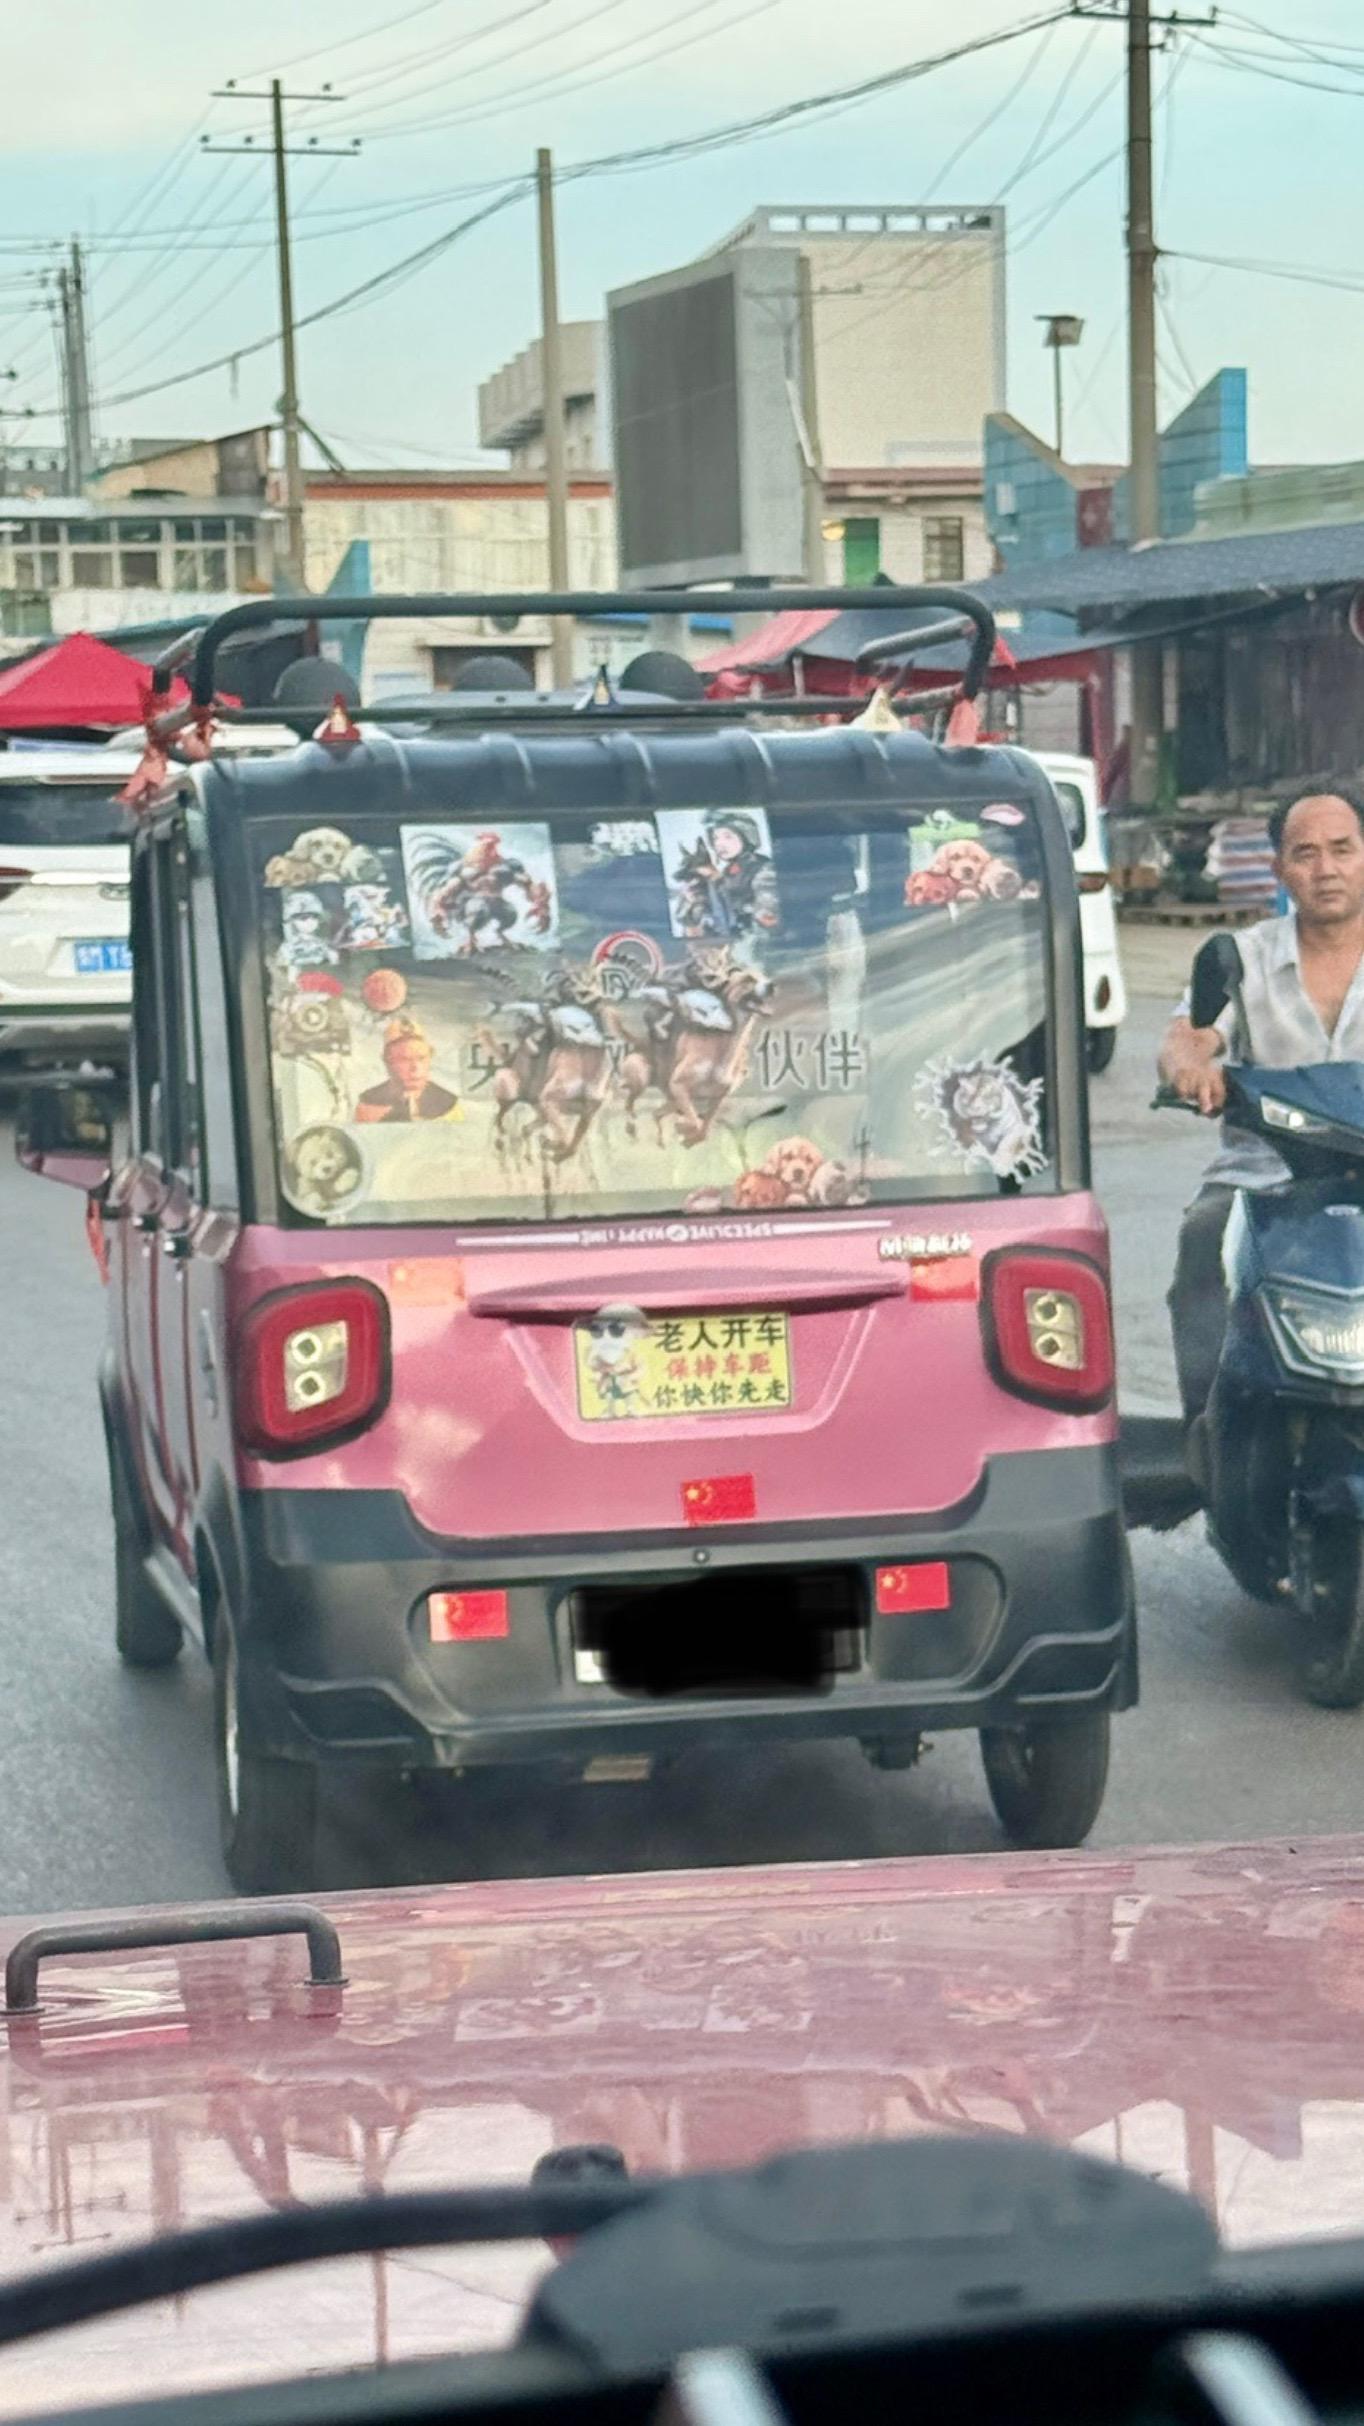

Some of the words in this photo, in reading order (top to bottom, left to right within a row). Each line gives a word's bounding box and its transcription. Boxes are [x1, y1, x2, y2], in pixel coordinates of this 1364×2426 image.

[756, 1029, 863, 1088] 伙伴
[654, 1316, 785, 1353] 老人开车
[666, 1351, 773, 1379] 保持车距
[653, 1378, 787, 1408] 你快你先走
